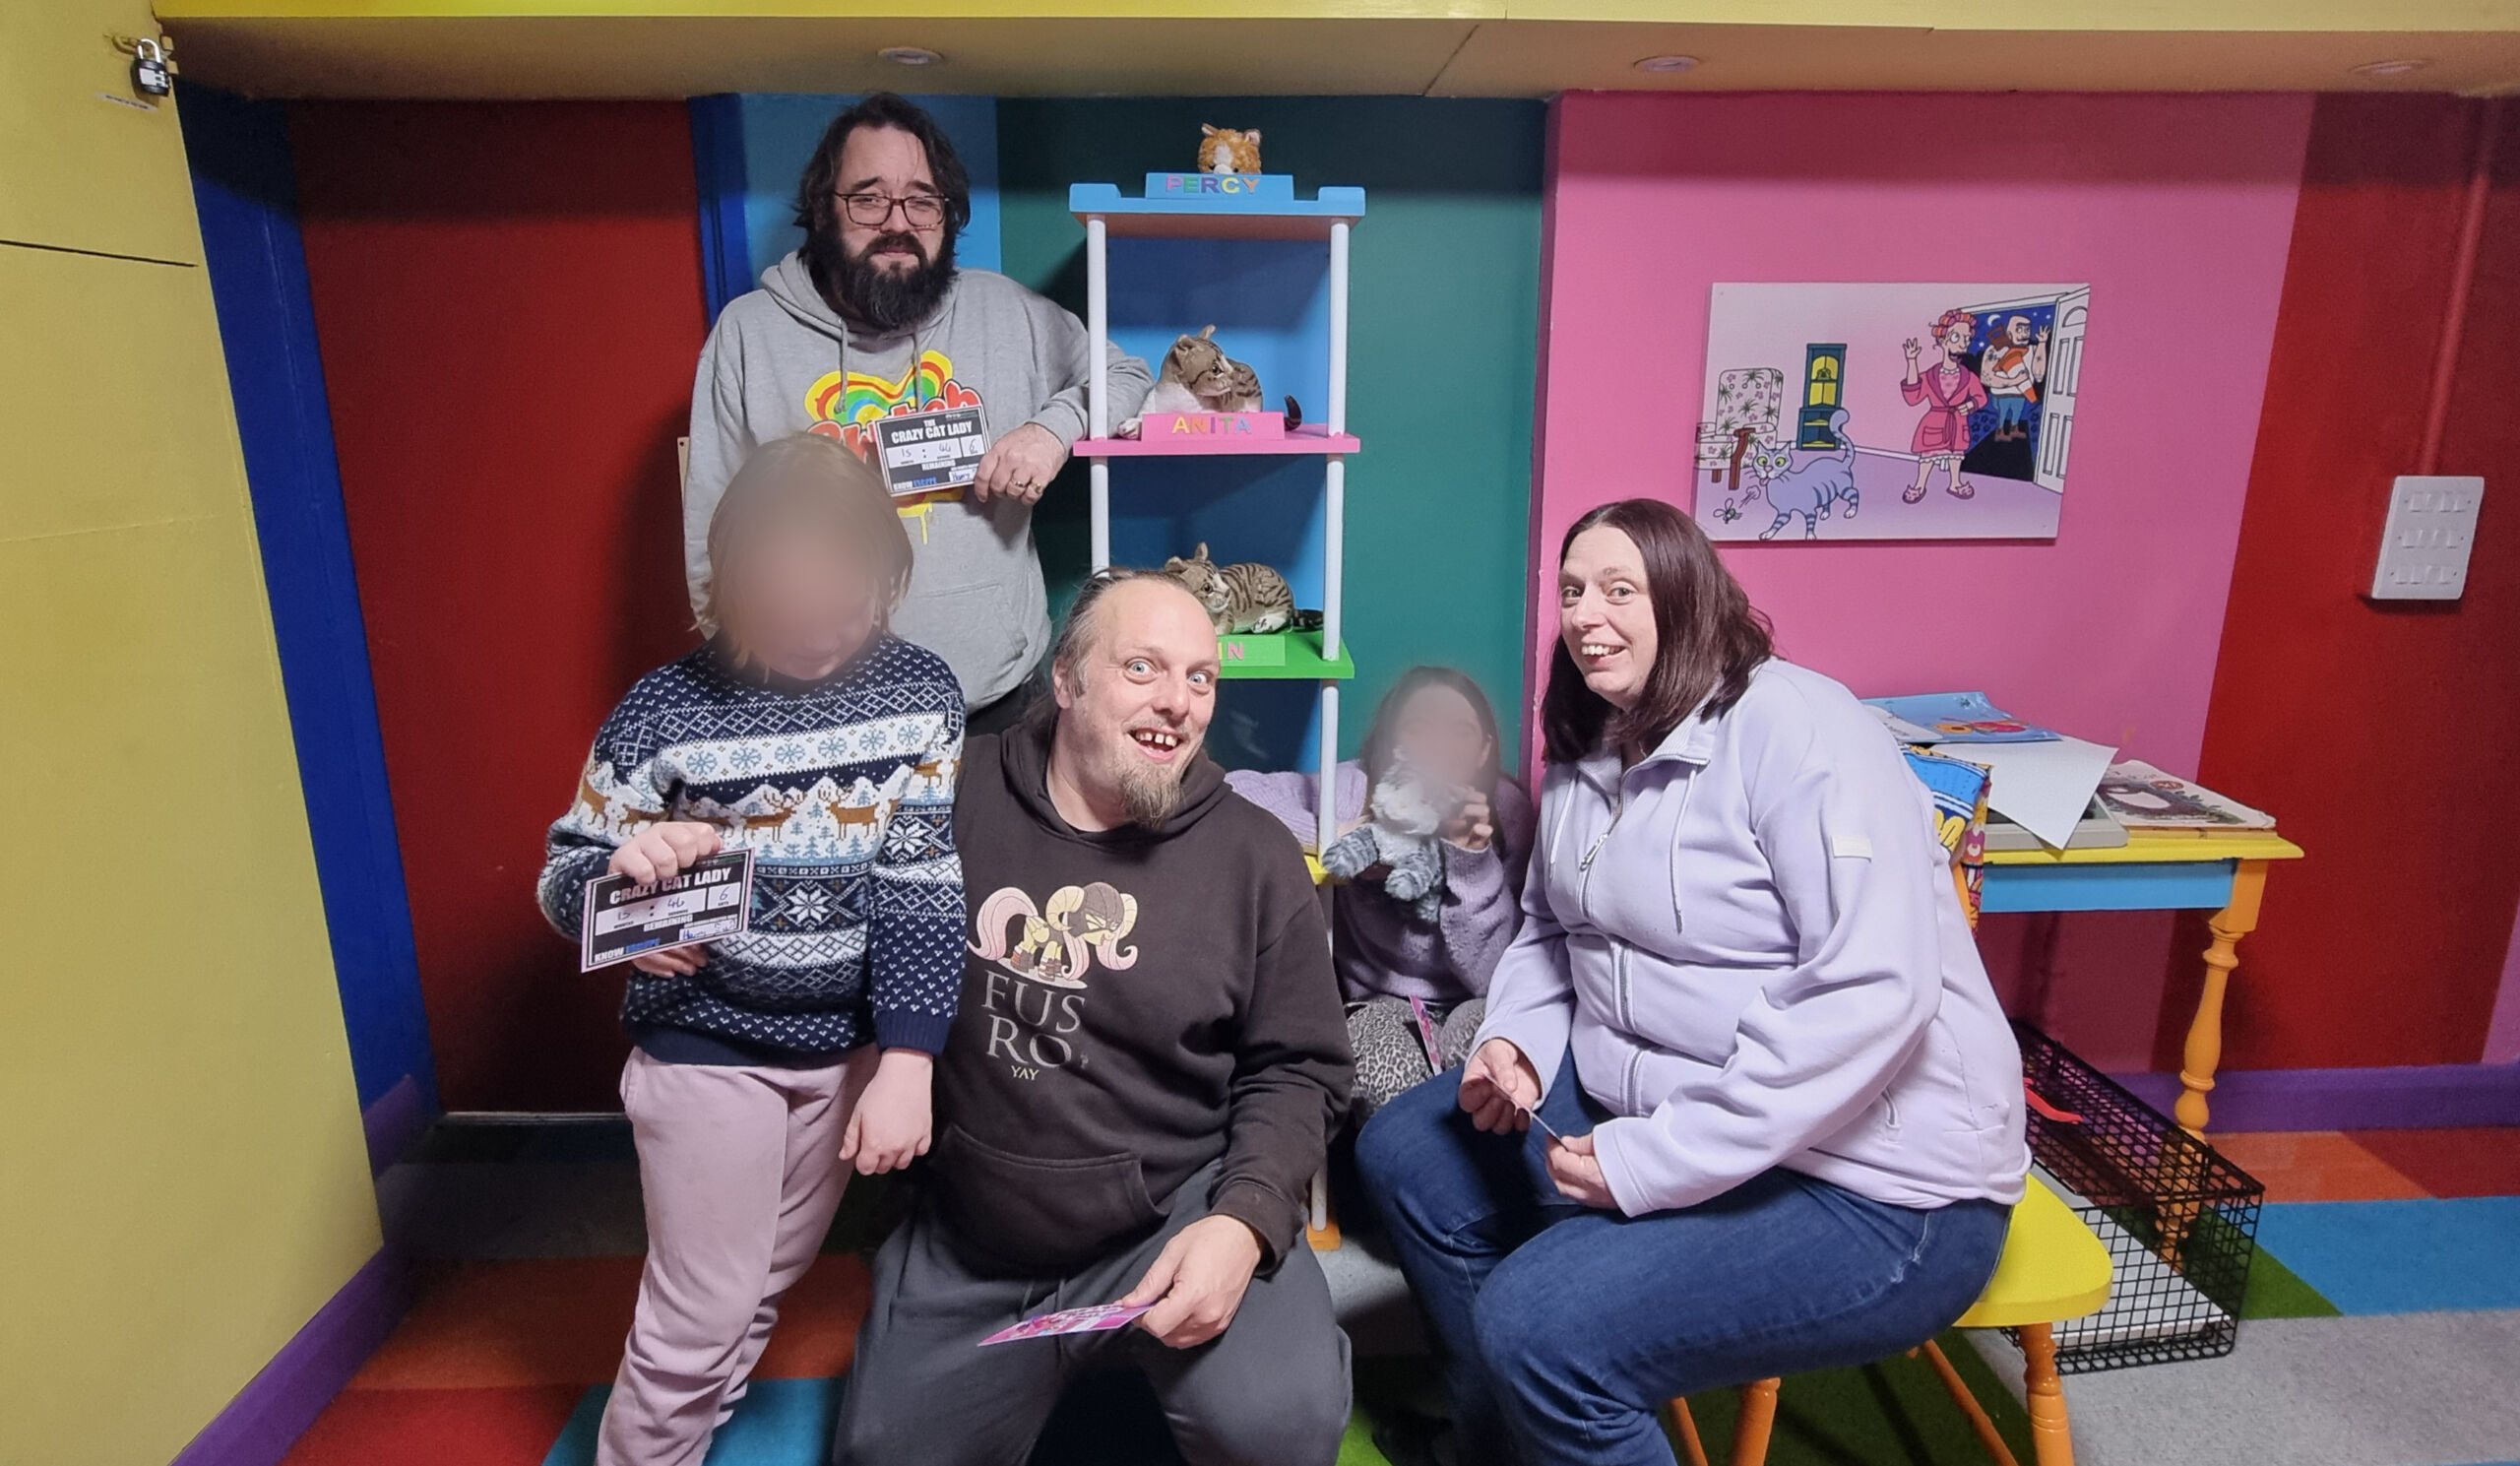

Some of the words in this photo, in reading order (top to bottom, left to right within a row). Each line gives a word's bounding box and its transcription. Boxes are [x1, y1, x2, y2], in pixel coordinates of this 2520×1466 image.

[1166, 175, 1261, 194] PERCY
[891, 427, 924, 444] CRAZY
[924, 424, 946, 439] CAT
[946, 420, 973, 436] LADY
[923, 418, 937, 427] THE
[1171, 415, 1251, 434] ANITA
[1216, 641, 1244, 661] IN
[609, 883, 657, 905] CRAZY
[661, 873, 692, 893] CAT
[694, 867, 731, 886] LADY
[719, 886, 731, 901] 6
[594, 945, 625, 964] KNOW
[980, 969, 1086, 1034] FUS
[1010, 1064, 1040, 1082] YAY
